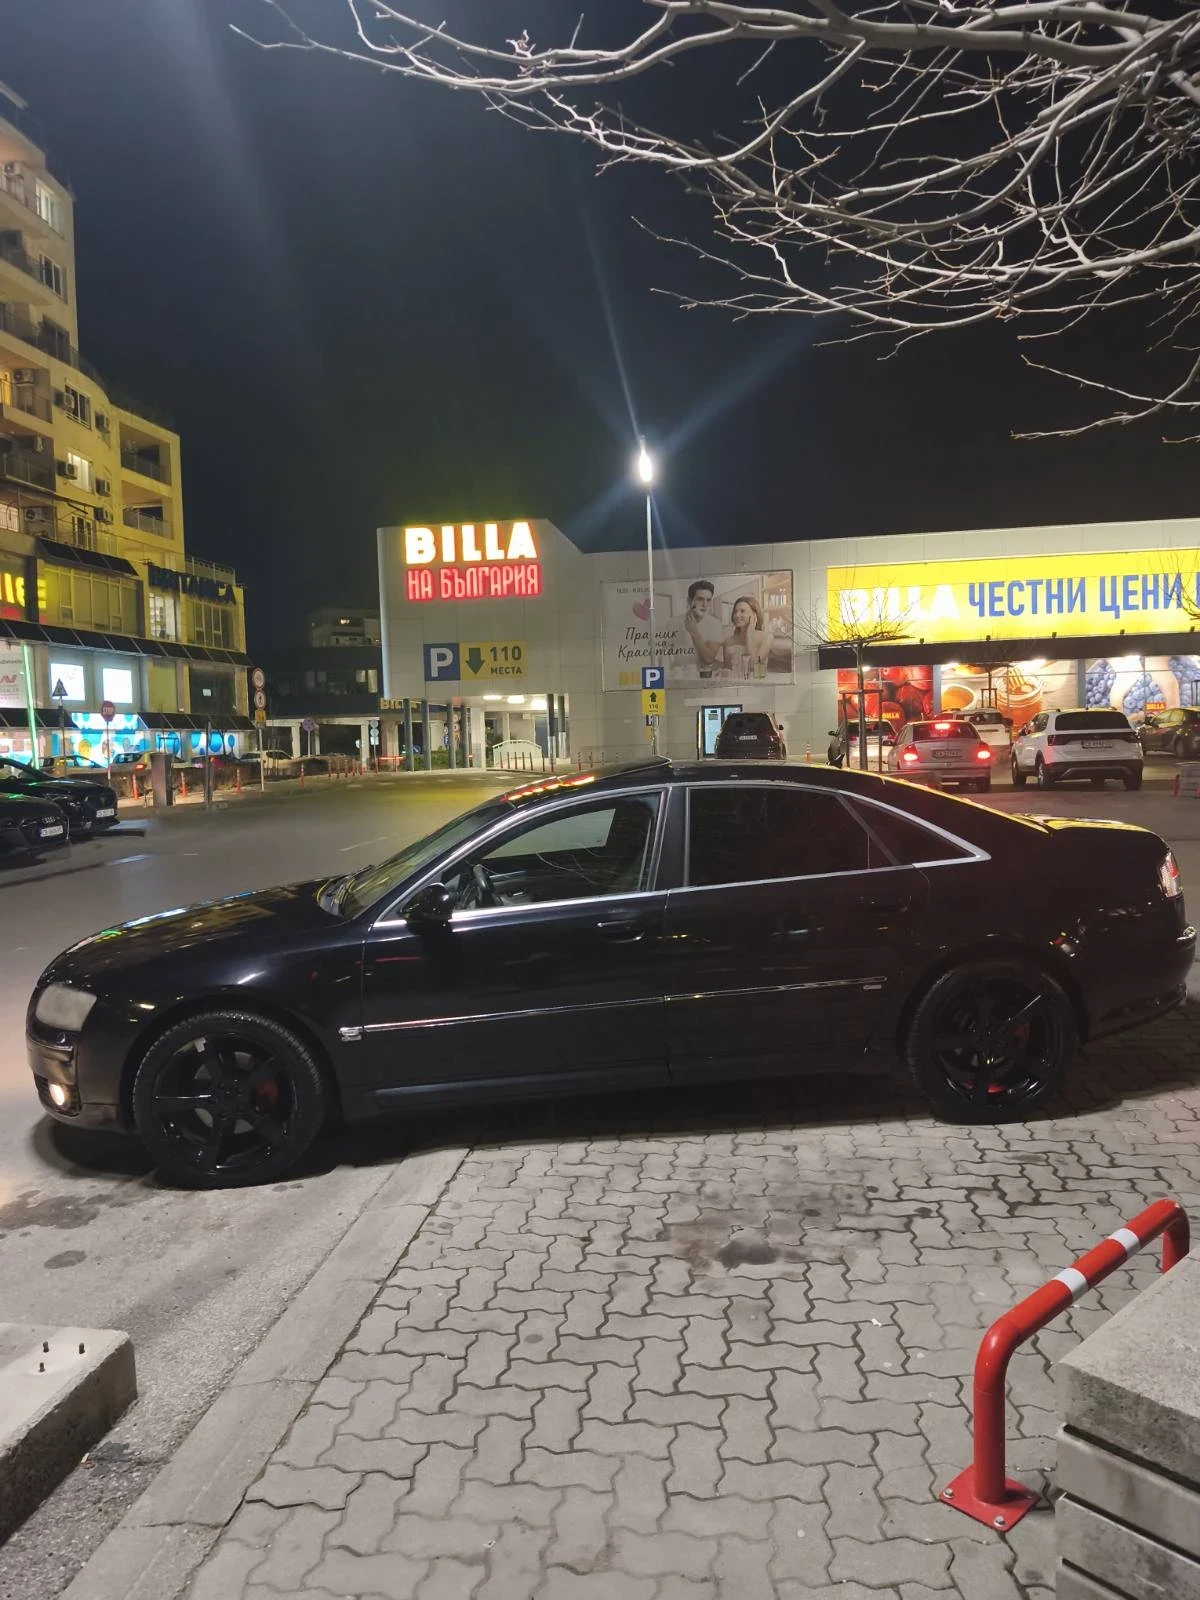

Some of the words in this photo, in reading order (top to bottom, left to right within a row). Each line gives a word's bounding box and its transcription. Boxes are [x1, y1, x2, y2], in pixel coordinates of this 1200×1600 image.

[405, 522, 537, 564] BILLA
[408, 570, 433, 600] НА
[440, 565, 539, 598] БЪЛГАРИЯ
[840, 584, 960, 623] BILLA
[968, 576, 1086, 617] ЧЕСТНИ
[1099, 573, 1183, 619] ЦЕНИ
[625, 627, 678, 645] Праник
[430, 648, 454, 677] P
[490, 646, 522, 662] 110
[490, 666, 523, 675] МЕСТА
[645, 669, 661, 688] P
